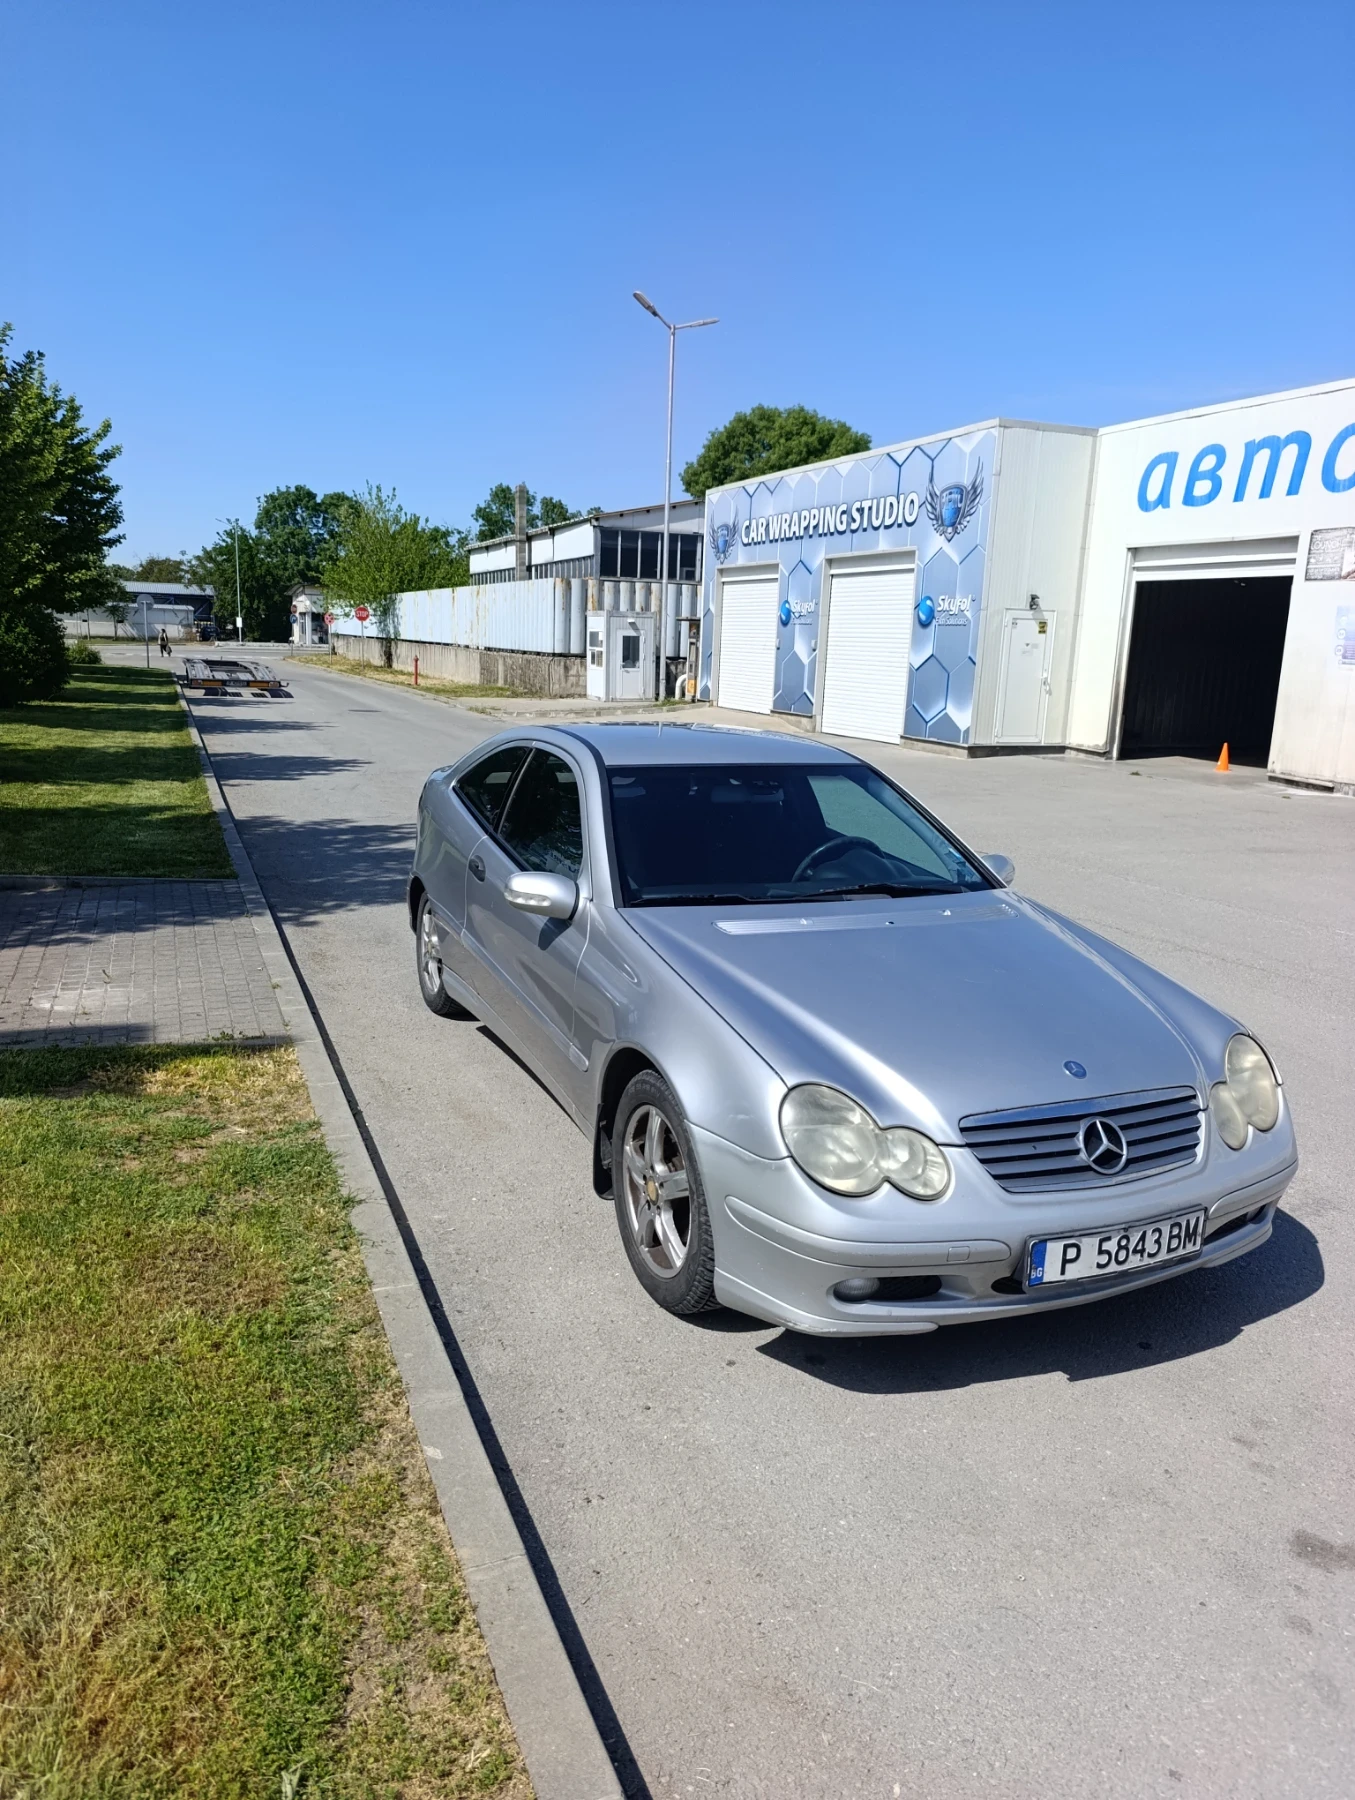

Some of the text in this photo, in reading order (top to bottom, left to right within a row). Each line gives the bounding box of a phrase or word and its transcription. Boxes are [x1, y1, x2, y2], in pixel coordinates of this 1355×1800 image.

[741, 516, 767, 545] CAR
[769, 503, 848, 541] WRAPPING
[850, 491, 919, 532] STUDIO
[356, 610, 369, 618] STOP
[1060, 1242, 1081, 1276] P
